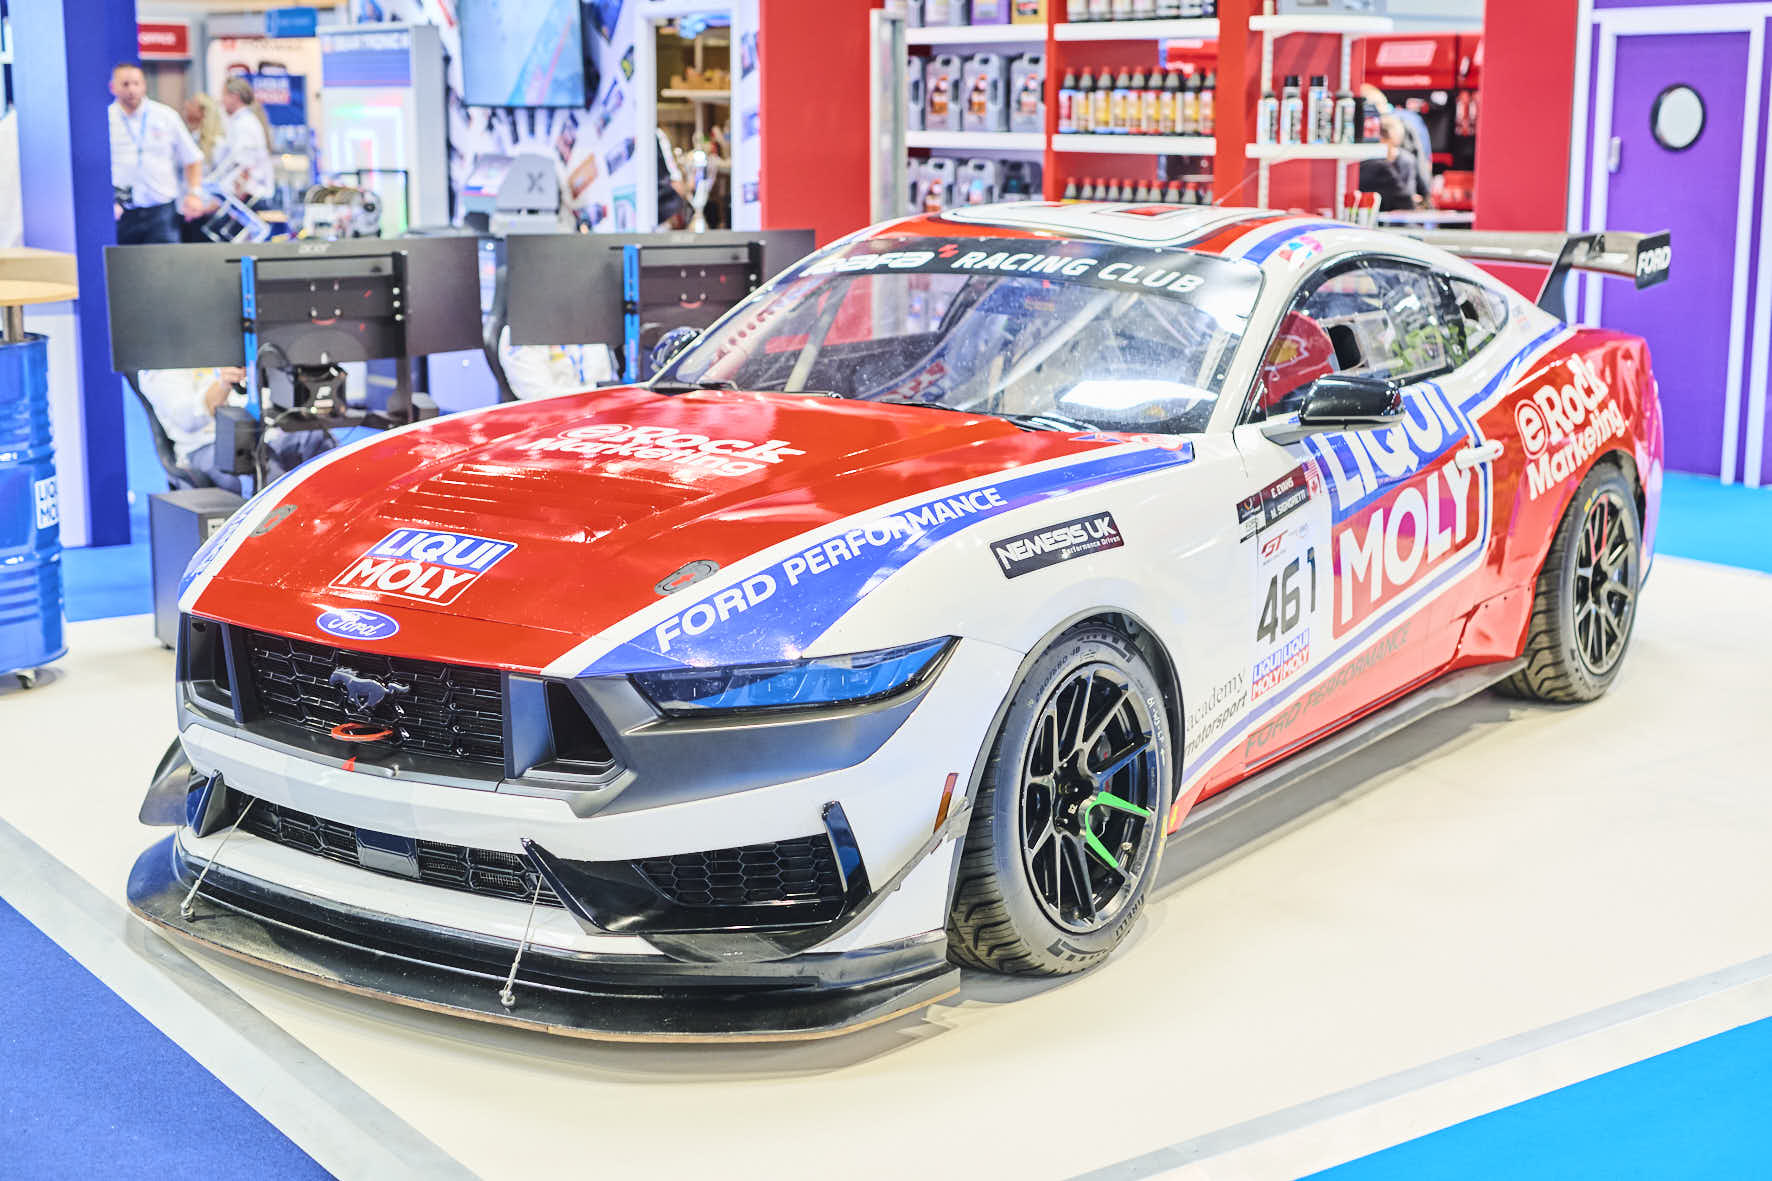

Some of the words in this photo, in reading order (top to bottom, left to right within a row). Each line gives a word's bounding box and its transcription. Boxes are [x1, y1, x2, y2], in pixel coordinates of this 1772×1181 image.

[951, 251, 1098, 276] RACING
[1098, 262, 1206, 293] CLUB
[1637, 245, 1672, 277] FORD
[517, 438, 766, 476] Marketing
[557, 424, 806, 463] eRock
[1312, 381, 1459, 512] LIQUI
[1526, 399, 1626, 501] Marketing
[374, 530, 509, 570] LIQUI
[996, 523, 1089, 570] NEMESIS
[1086, 516, 1117, 539] UK
[1339, 458, 1473, 625] MOLY
[338, 557, 477, 600] MOLY
[655, 573, 777, 653] FORD
[782, 486, 1009, 587] PERFORMANCE
[1256, 546, 1317, 645] 461
[328, 611, 384, 637] Ford
[1252, 665, 1282, 699] MOLY
[1254, 648, 1283, 683] LIQUI
[1186, 690, 1248, 756] motorsport
[1244, 701, 1301, 758] FORD
